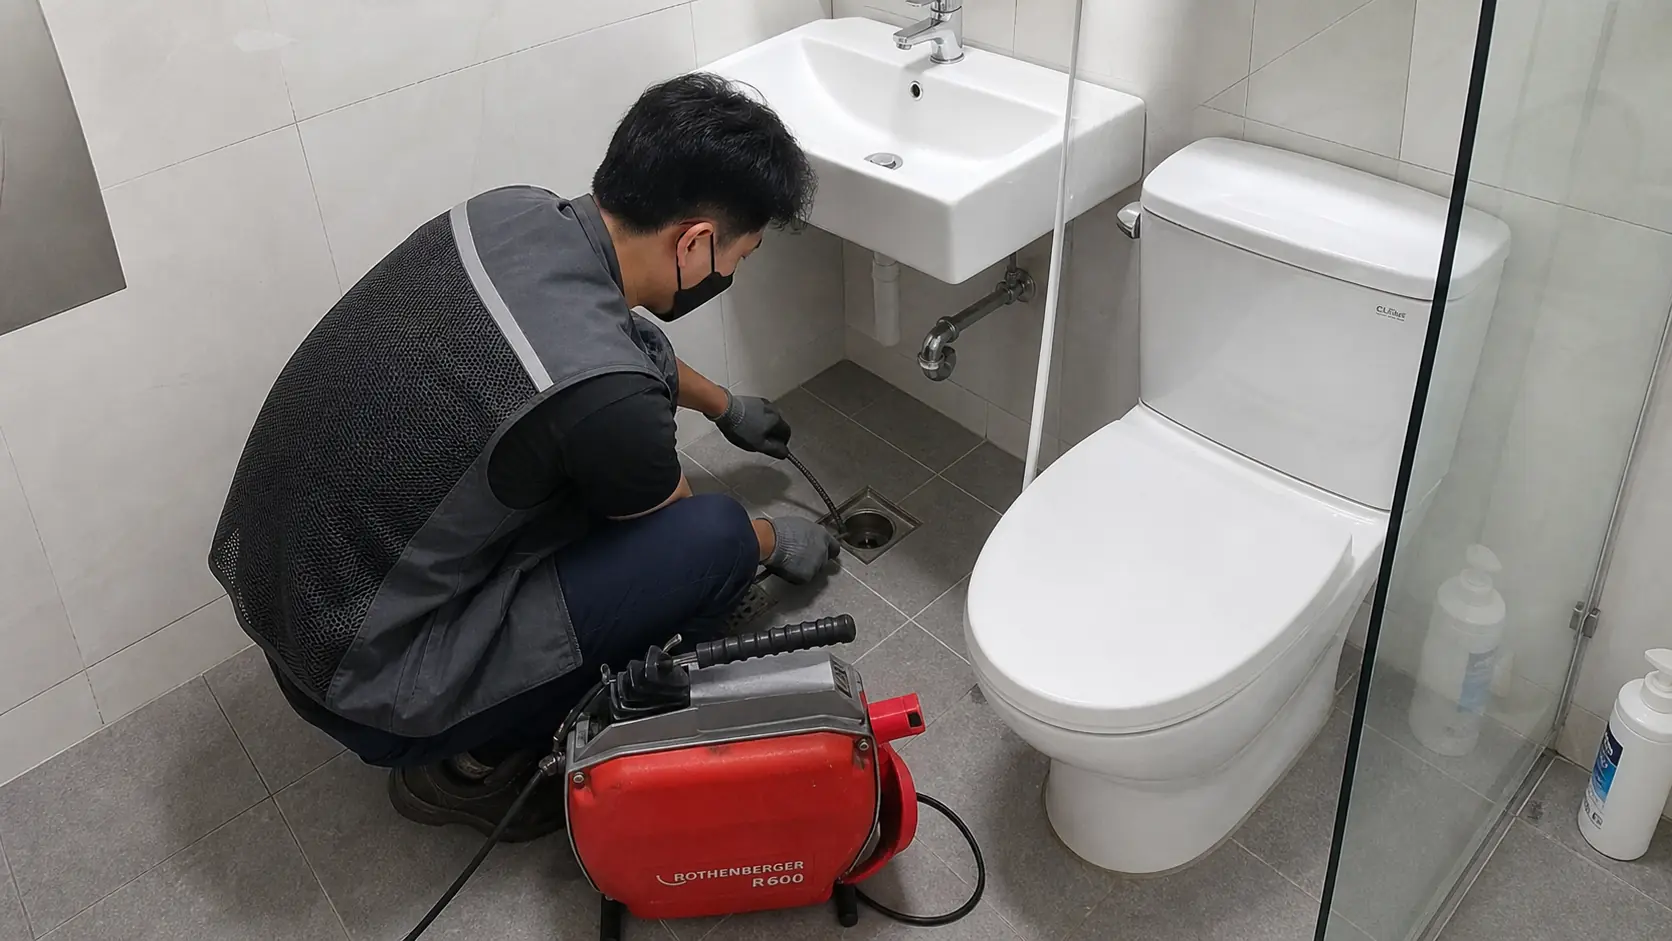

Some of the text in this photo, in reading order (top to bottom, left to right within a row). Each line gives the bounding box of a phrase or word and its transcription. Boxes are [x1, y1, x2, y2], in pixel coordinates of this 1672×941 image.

[674, 861, 804, 882] ROTHENBERGER
[752, 873, 804, 888] R 600
